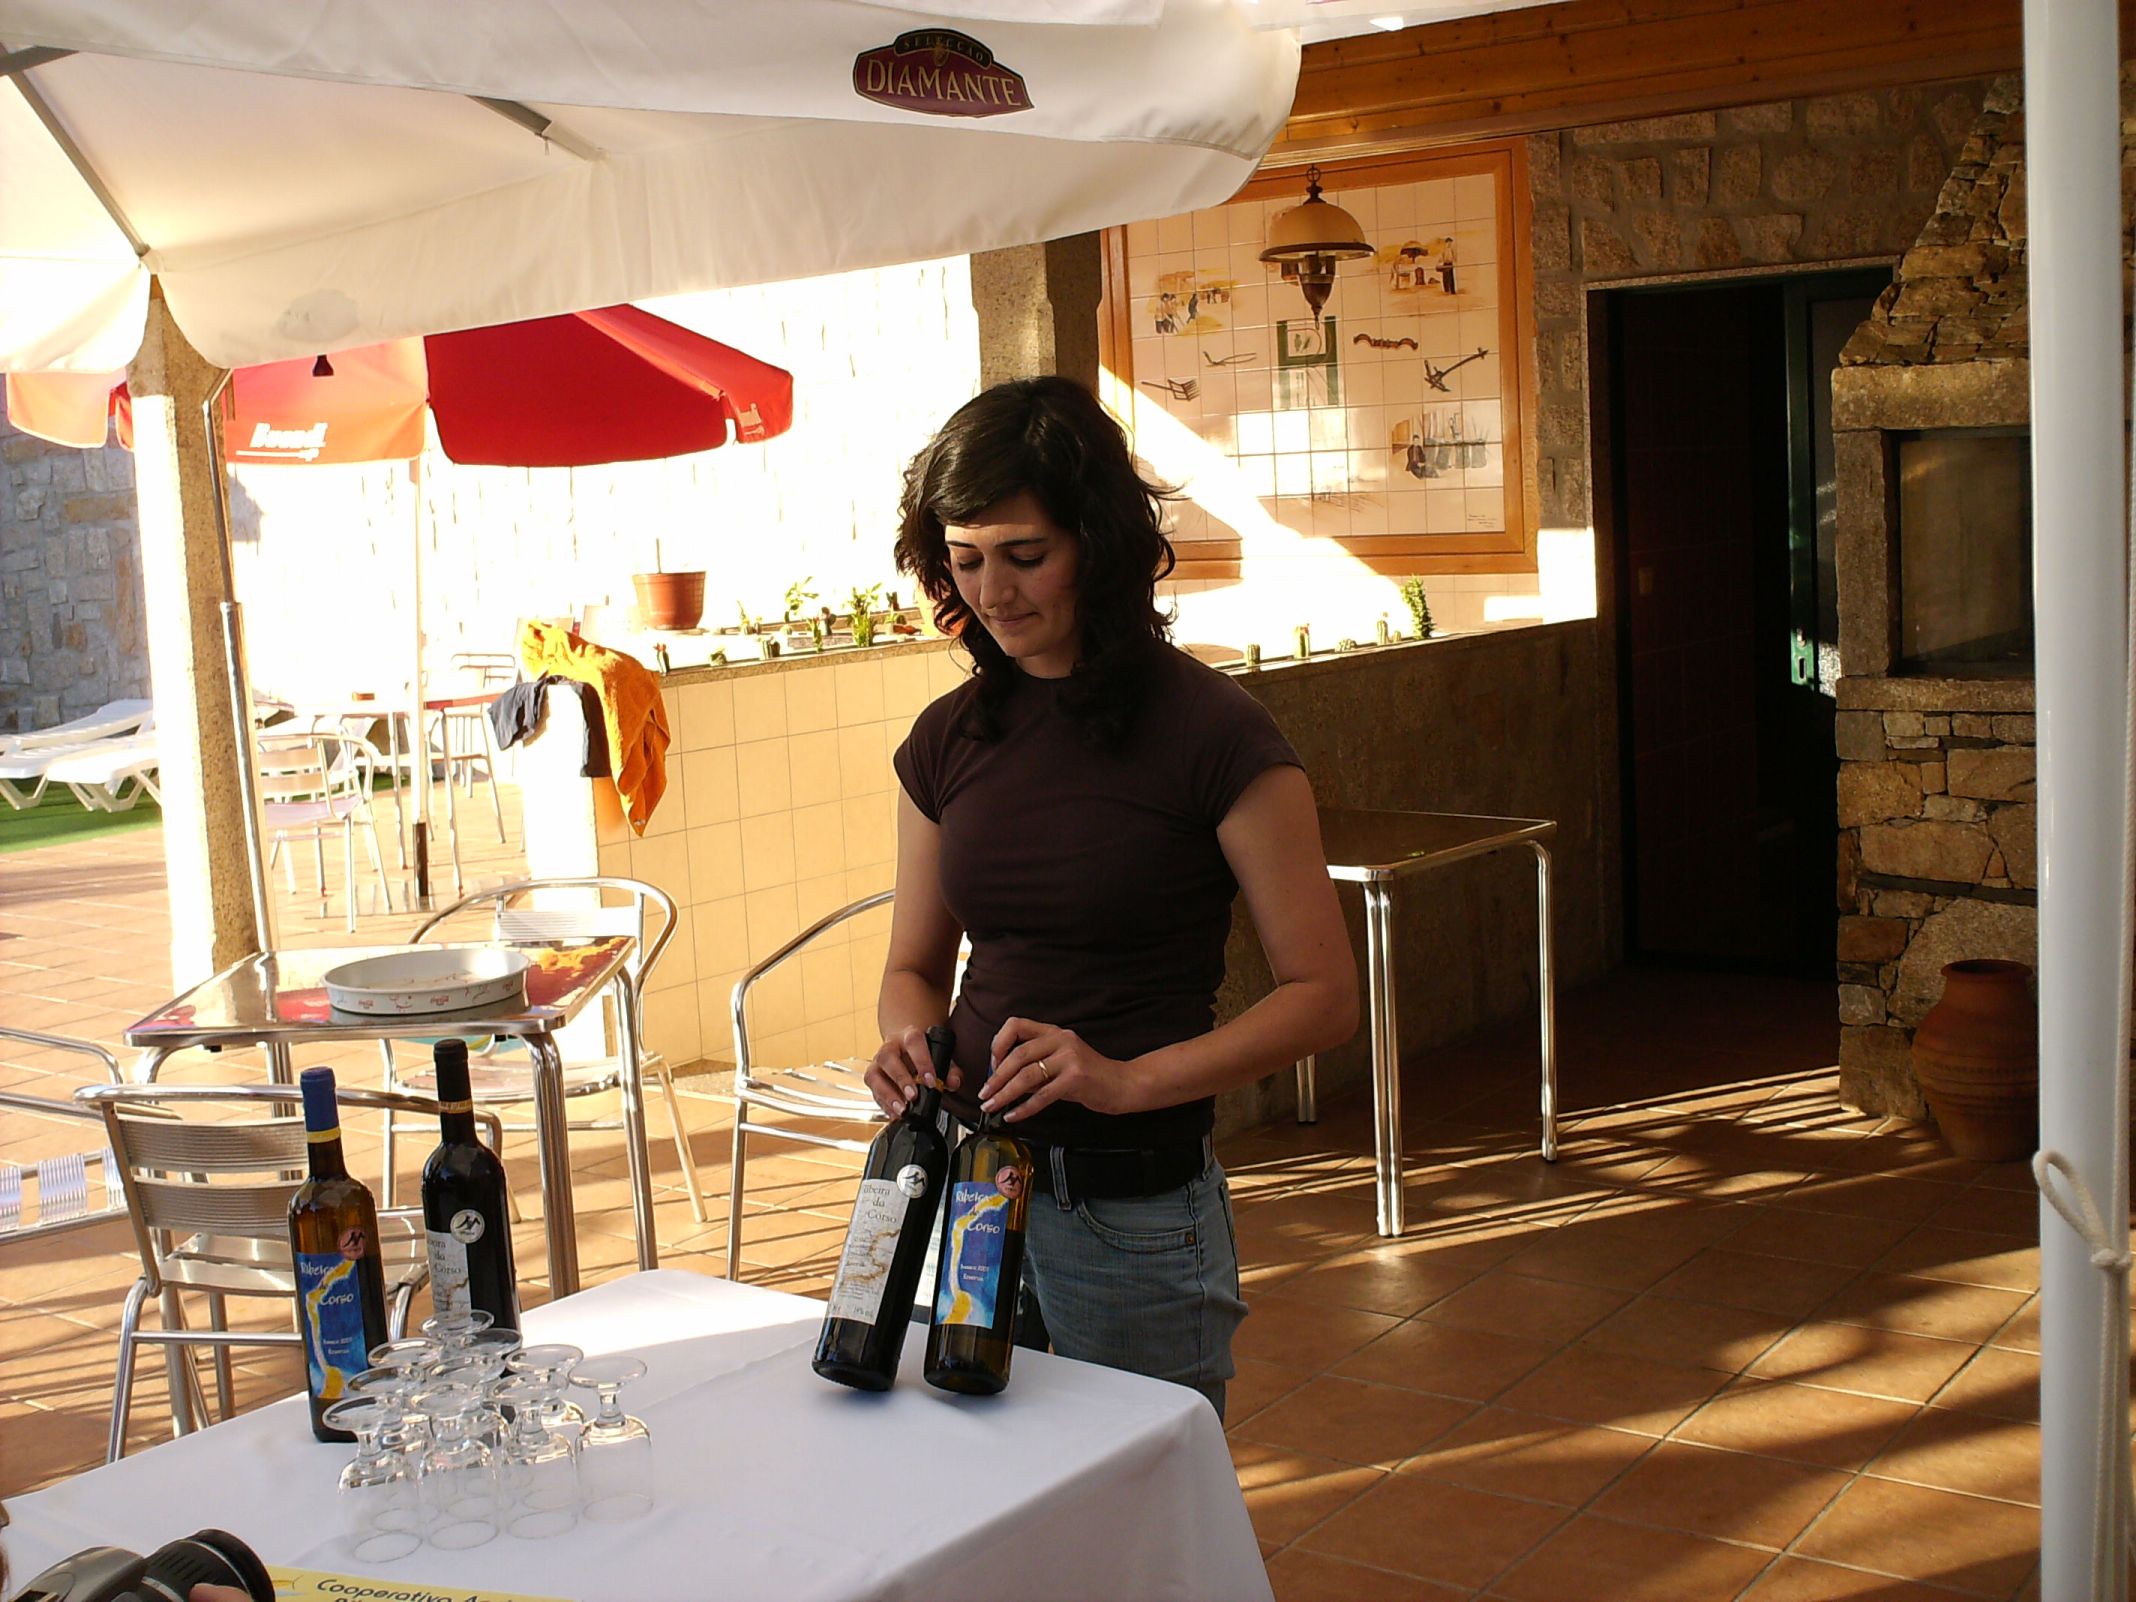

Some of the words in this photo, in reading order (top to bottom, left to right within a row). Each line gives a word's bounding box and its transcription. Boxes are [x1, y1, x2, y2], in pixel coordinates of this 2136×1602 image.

[866, 59, 1022, 106] DIAMANTE
[867, 1209, 898, 1223] Corso
[967, 1219, 1001, 1234] Corso
[319, 1292, 354, 1306] Corso
